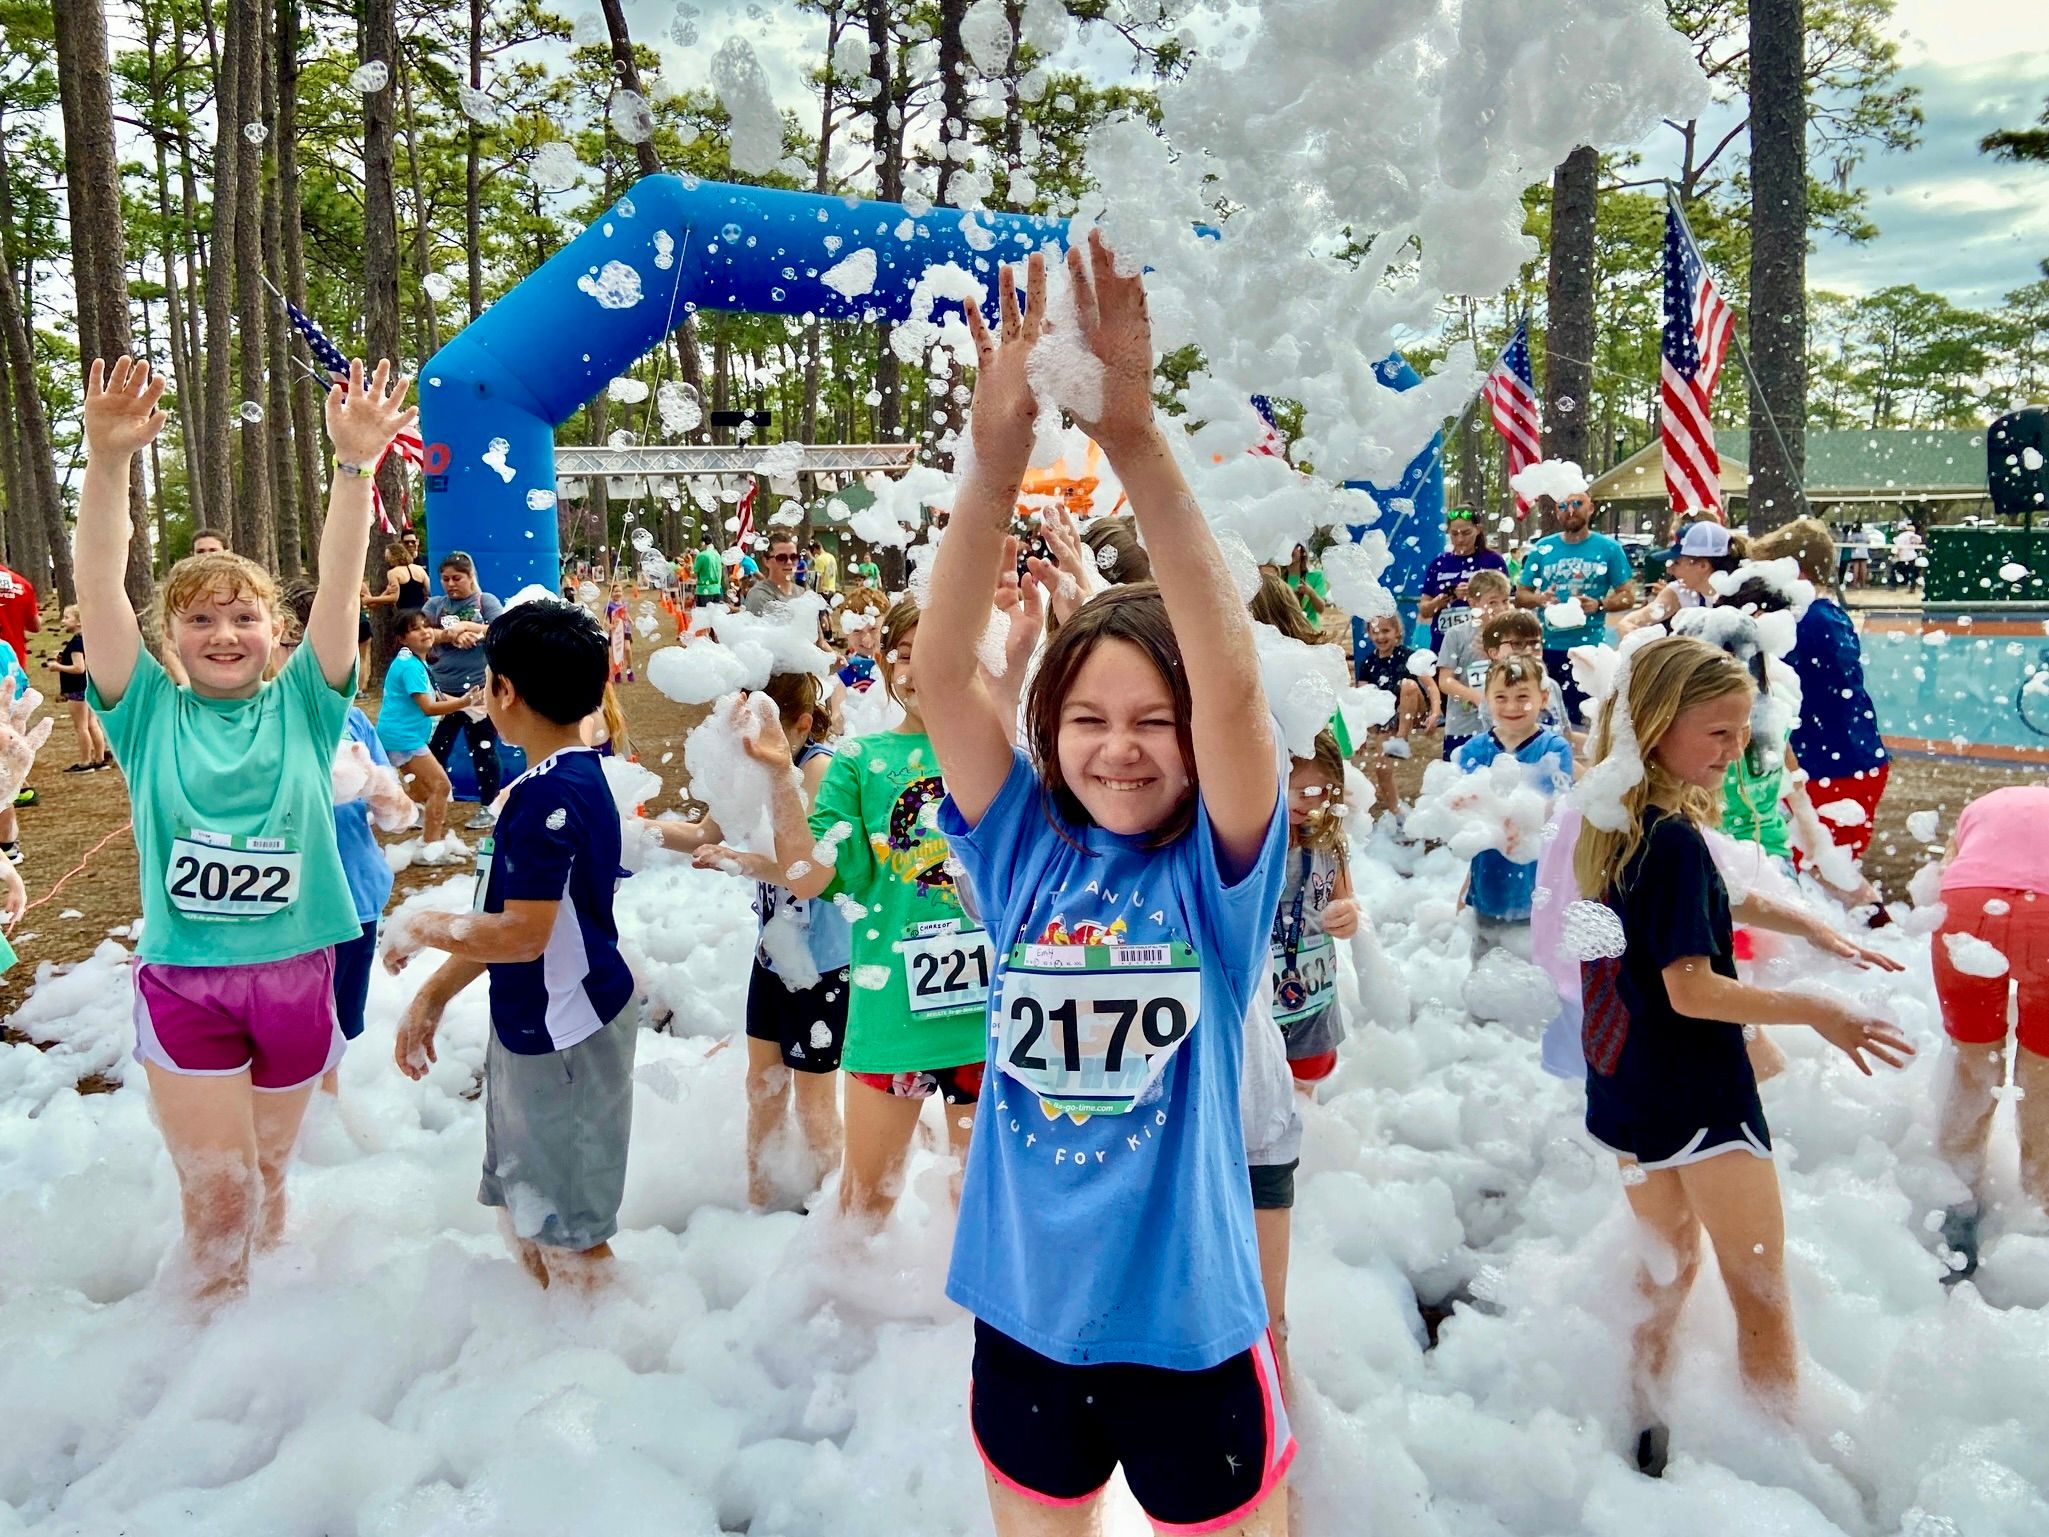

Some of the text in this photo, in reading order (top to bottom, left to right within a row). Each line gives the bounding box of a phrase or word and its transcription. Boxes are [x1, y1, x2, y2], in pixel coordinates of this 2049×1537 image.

[424, 442, 452, 475] O
[170, 855, 291, 903] 2022
[1008, 996, 1188, 1073] 2179
[1126, 1109, 1168, 1152] Kid
